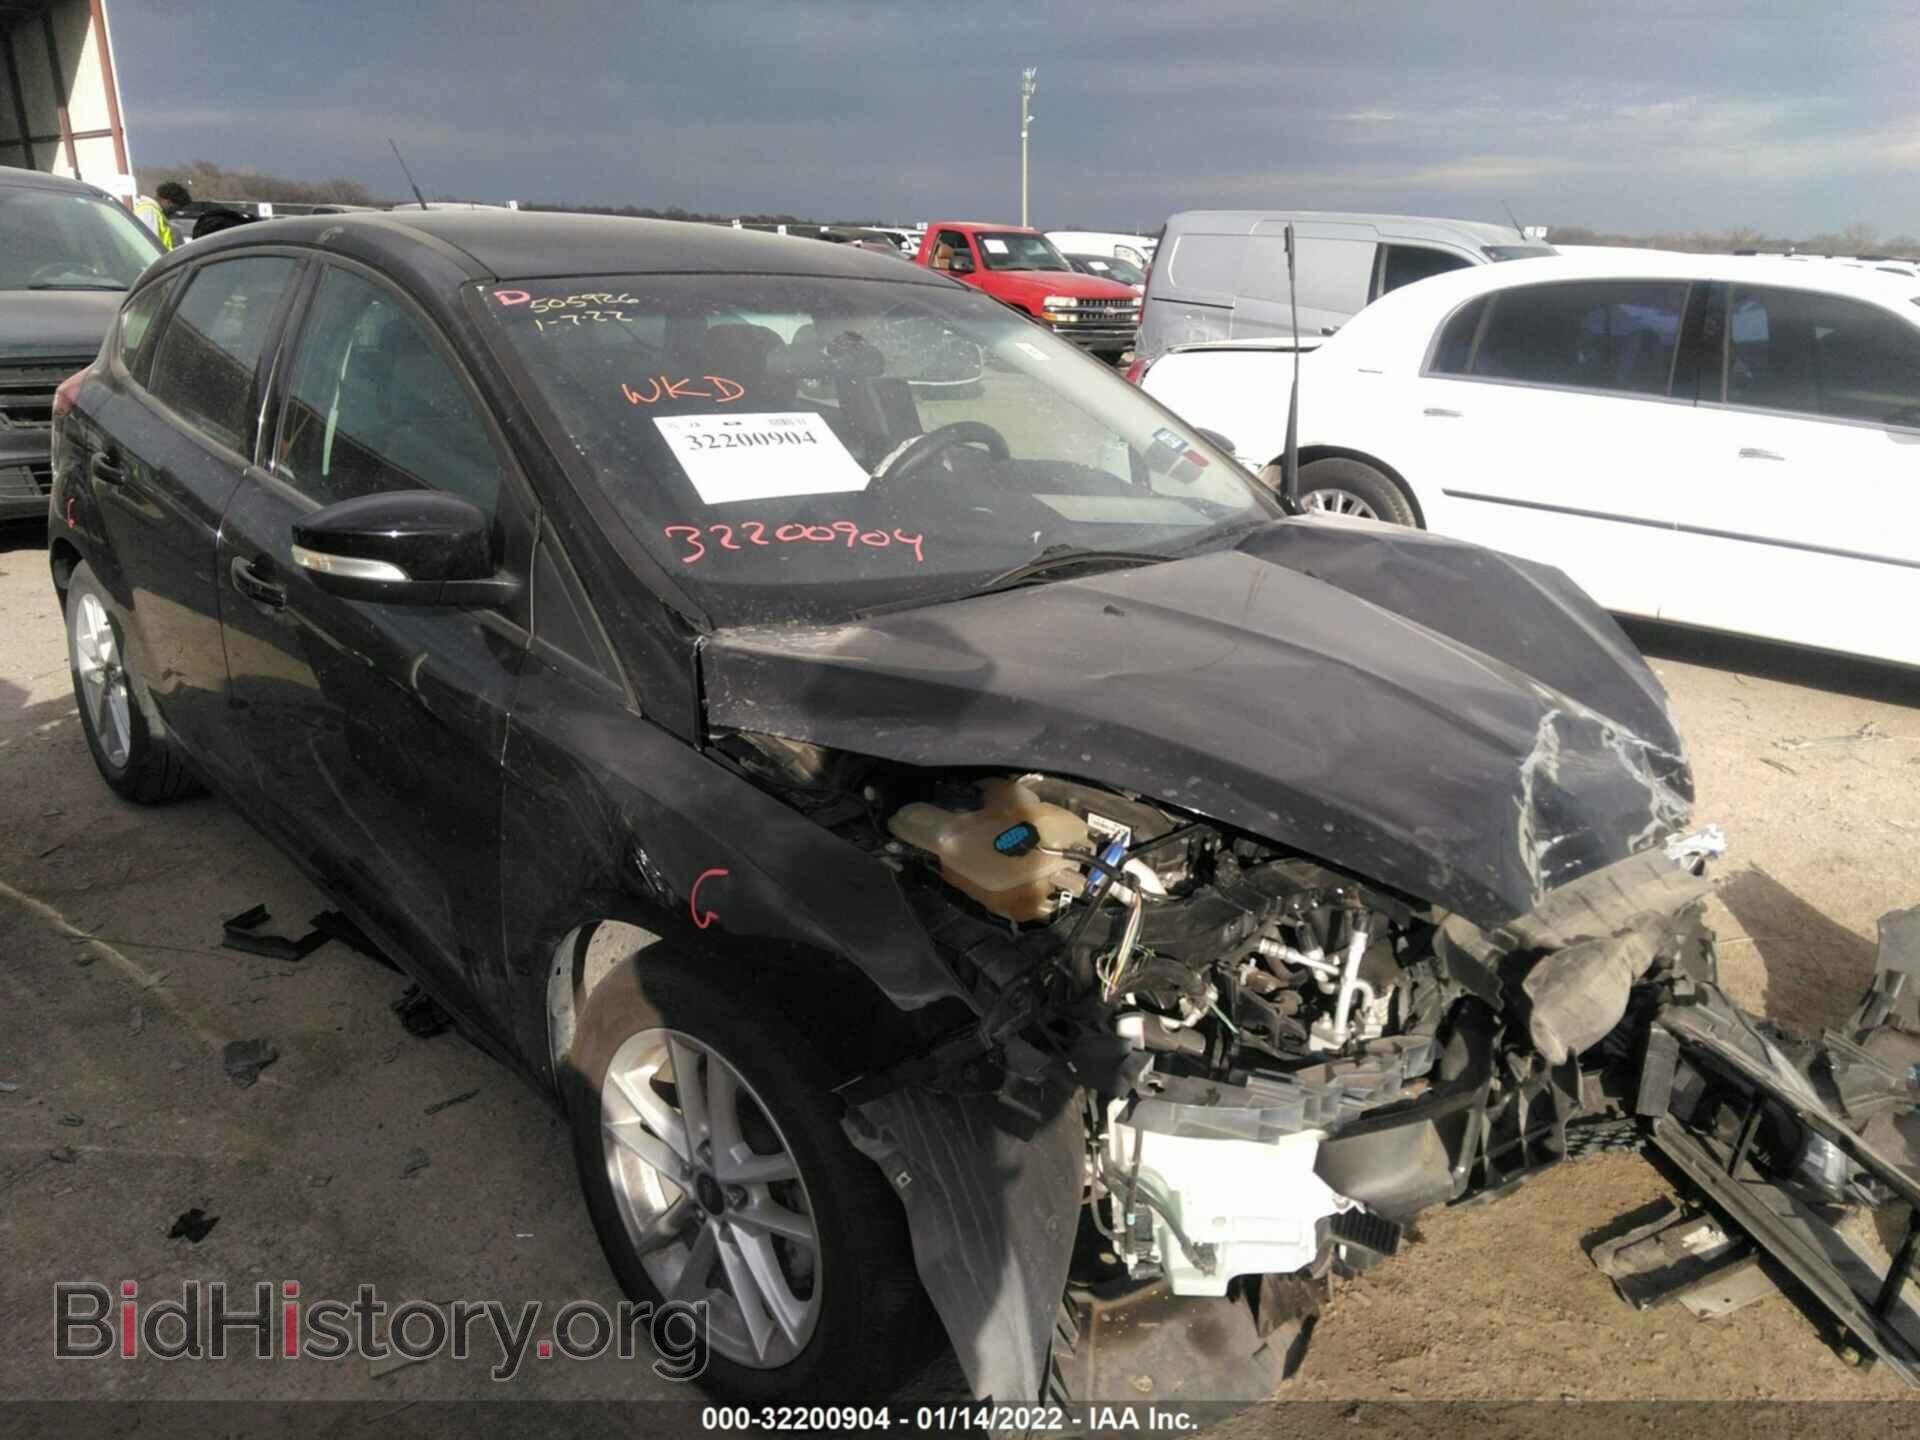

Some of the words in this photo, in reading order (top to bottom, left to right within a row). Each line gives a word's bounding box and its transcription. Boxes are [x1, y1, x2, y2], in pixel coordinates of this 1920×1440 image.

[493, 289, 530, 306] D
[529, 292, 640, 314] 505926
[685, 431, 818, 450] 32200904
[664, 522, 925, 564] 32200904
